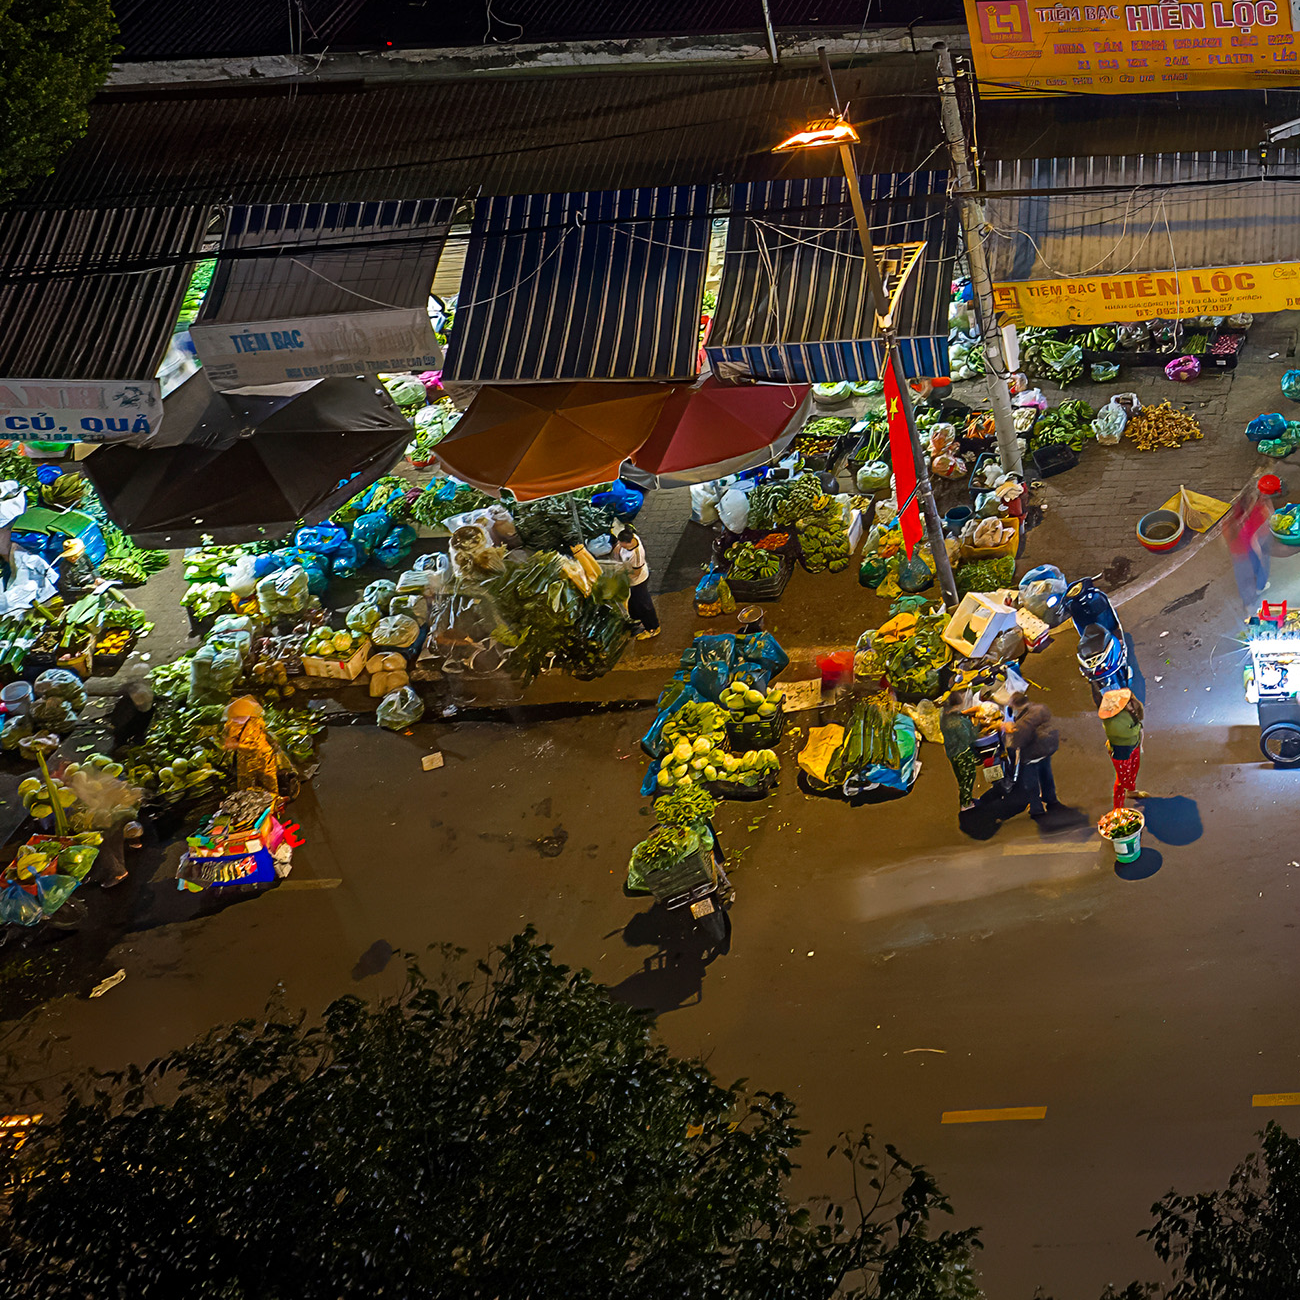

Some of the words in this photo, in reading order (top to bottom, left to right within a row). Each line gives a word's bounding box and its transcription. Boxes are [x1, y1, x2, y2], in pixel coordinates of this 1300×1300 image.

[1035, 3, 1080, 26] TIỆM
[1085, 5, 1120, 24] BẠC
[1192, 271, 1255, 296] LỘC
[271, 330, 304, 352] BẠC
[5, 412, 68, 432] CỦ,
[80, 413, 151, 434] QUẢ
